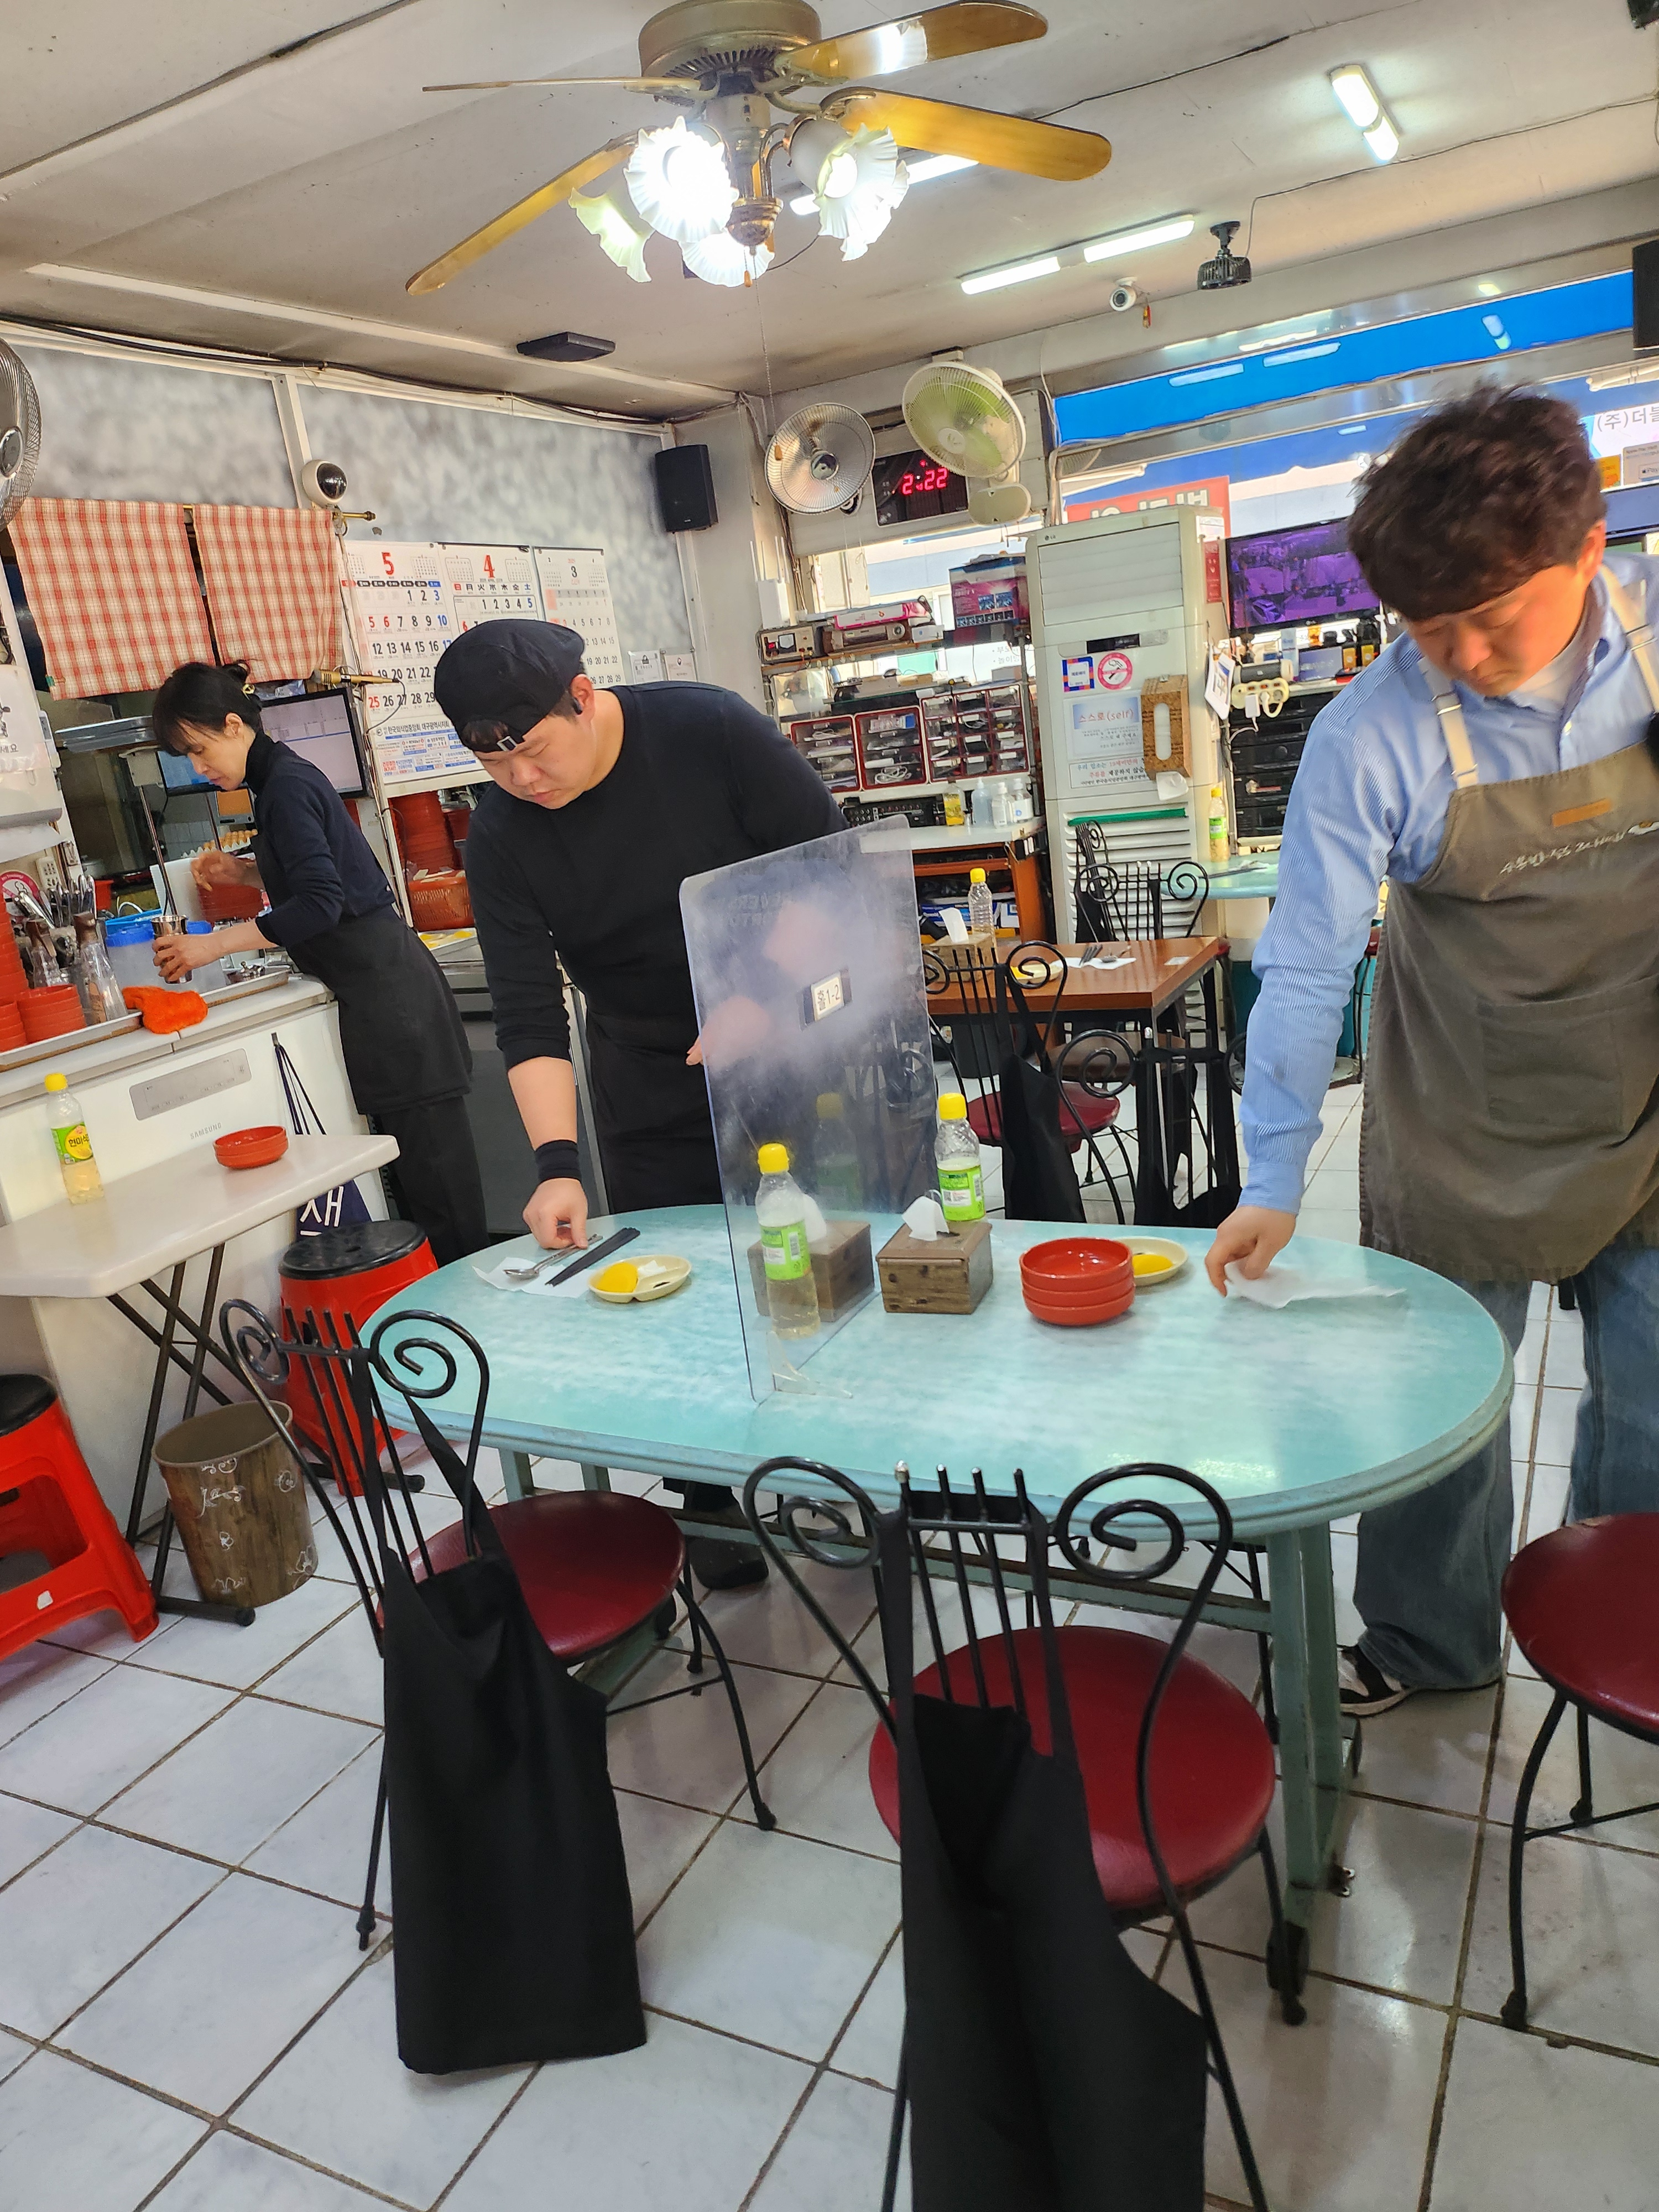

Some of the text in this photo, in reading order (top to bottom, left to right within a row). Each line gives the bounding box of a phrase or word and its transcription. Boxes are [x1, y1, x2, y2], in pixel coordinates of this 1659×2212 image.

[382, 552, 394, 575] 5
[484, 555, 495, 578] 4
[571, 566, 577, 578] 3
[408, 589, 440, 602] 1 2 3
[482, 598, 533, 610] 1 2 3 4 5
[369, 614, 447, 628] 5 6 7 8 9 10
[372, 643, 383, 655] 12
[387, 642, 397, 654] 13
[400, 641, 411, 654] 14
[415, 641, 425, 653] 15
[429, 640, 439, 651] 16
[586, 658, 593, 666] 19
[612, 655, 618, 664] 22
[392, 668, 403, 680] 20
[406, 667, 416, 679] 21
[419, 666, 431, 678] 22
[598, 676, 604, 684] 27
[615, 674, 621, 682] 29
[368, 696, 380, 708] 25
[382, 695, 394, 707] 26
[411, 693, 422, 705] 28
[424, 692, 436, 703] 29
[1079, 708, 1134, 723] 스스로(self)
[388, 723, 421, 734] 한국외식업중앙회
[190, 1122, 222, 1140] SAMSUNG
